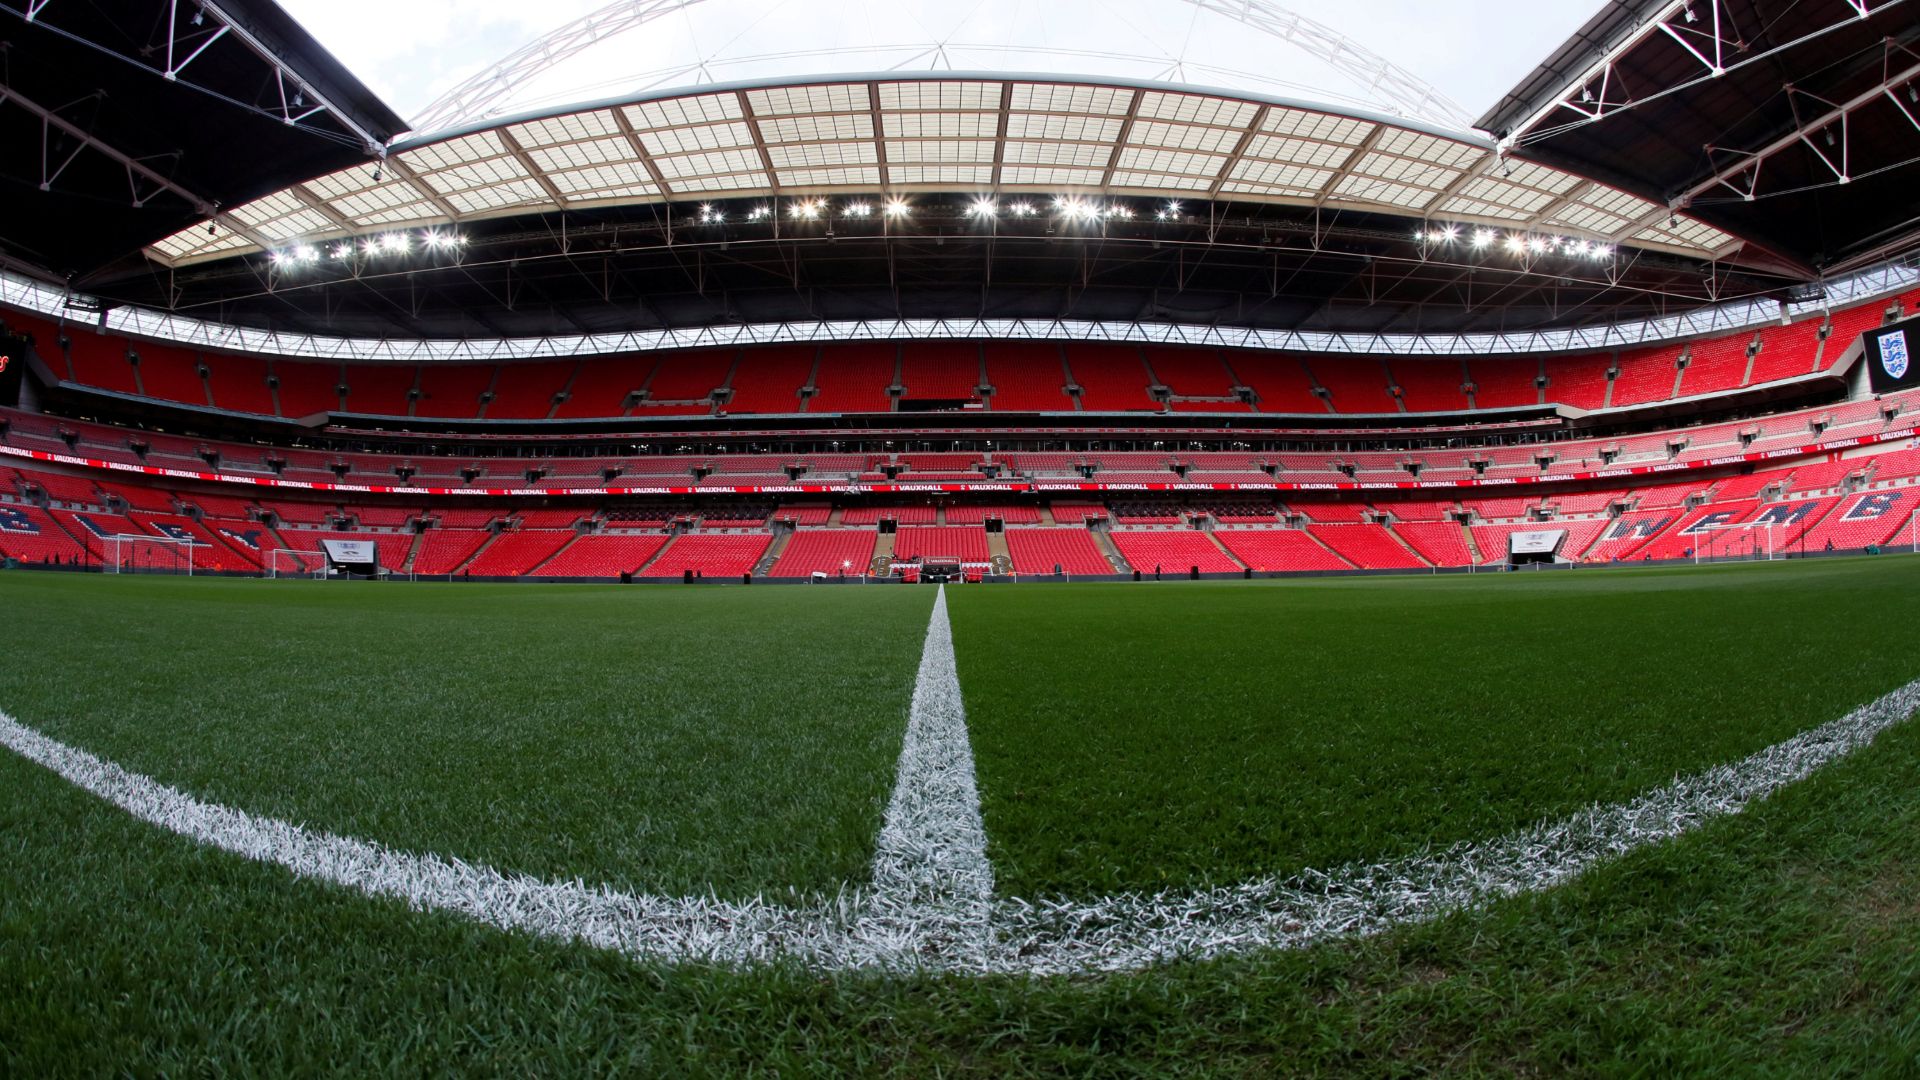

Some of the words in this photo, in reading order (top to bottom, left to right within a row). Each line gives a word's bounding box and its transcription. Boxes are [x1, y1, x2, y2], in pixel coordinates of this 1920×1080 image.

[1879, 429, 1915, 441] VAUXHALL
[1823, 439, 1860, 450] VAUXHALL
[1767, 448, 1803, 458] VAUXHALL
[53, 454, 88, 466] VAUXHALL
[1710, 456, 1747, 465] VAUXHALL
[109, 462, 145, 472] VAUXHALL
[1653, 463, 1689, 472] VAUXHALL
[165, 469, 200, 478] VAUXHALL
[1595, 469, 1632, 477] VAUXHALL
[221, 475, 257, 484] VAUXHALL
[1537, 474, 1575, 482] VAUXHALL
[277, 480, 313, 488] VAUXHALL
